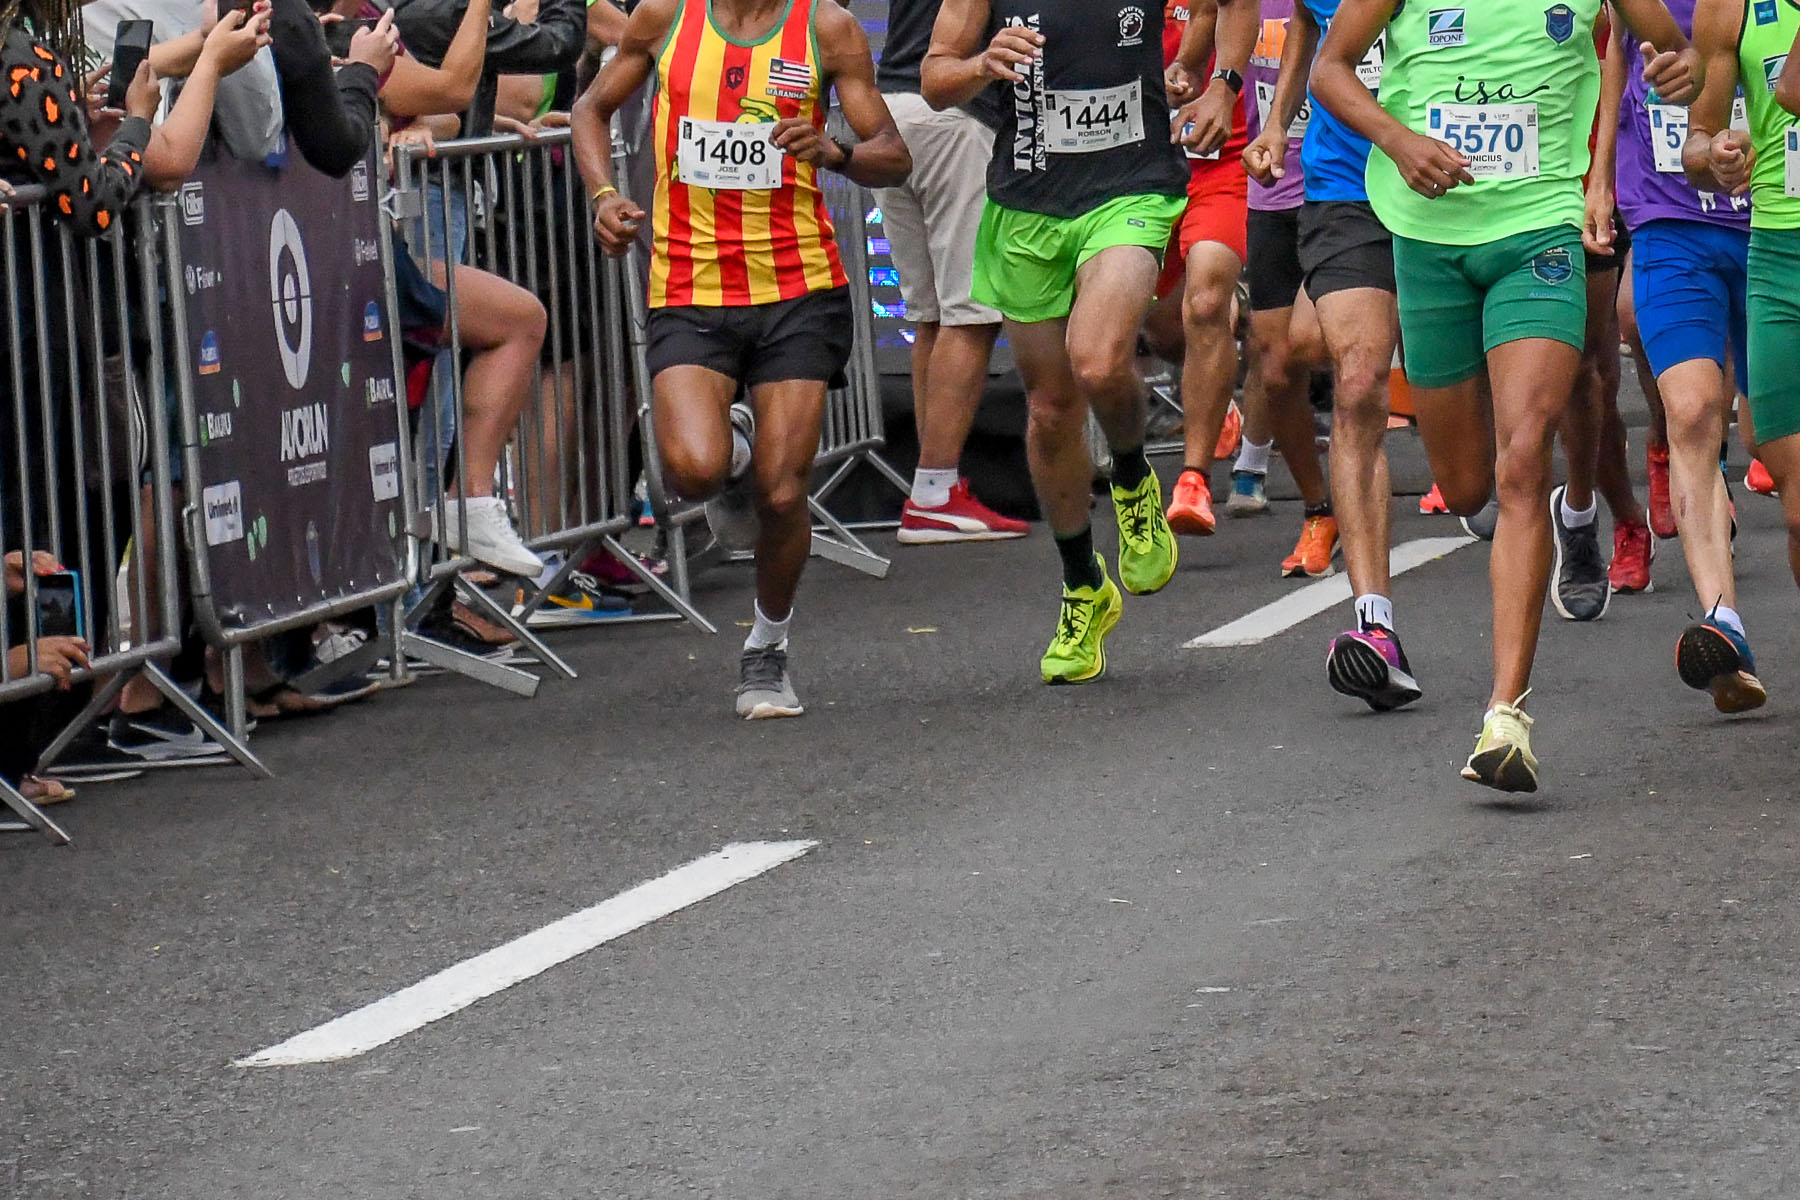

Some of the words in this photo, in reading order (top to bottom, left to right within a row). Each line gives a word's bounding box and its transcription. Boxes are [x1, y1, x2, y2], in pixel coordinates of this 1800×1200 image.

[1454, 75, 1550, 104] isa
[1059, 100, 1129, 130] 1444
[694, 136, 766, 166] 1408
[1444, 123, 1524, 154] 5570
